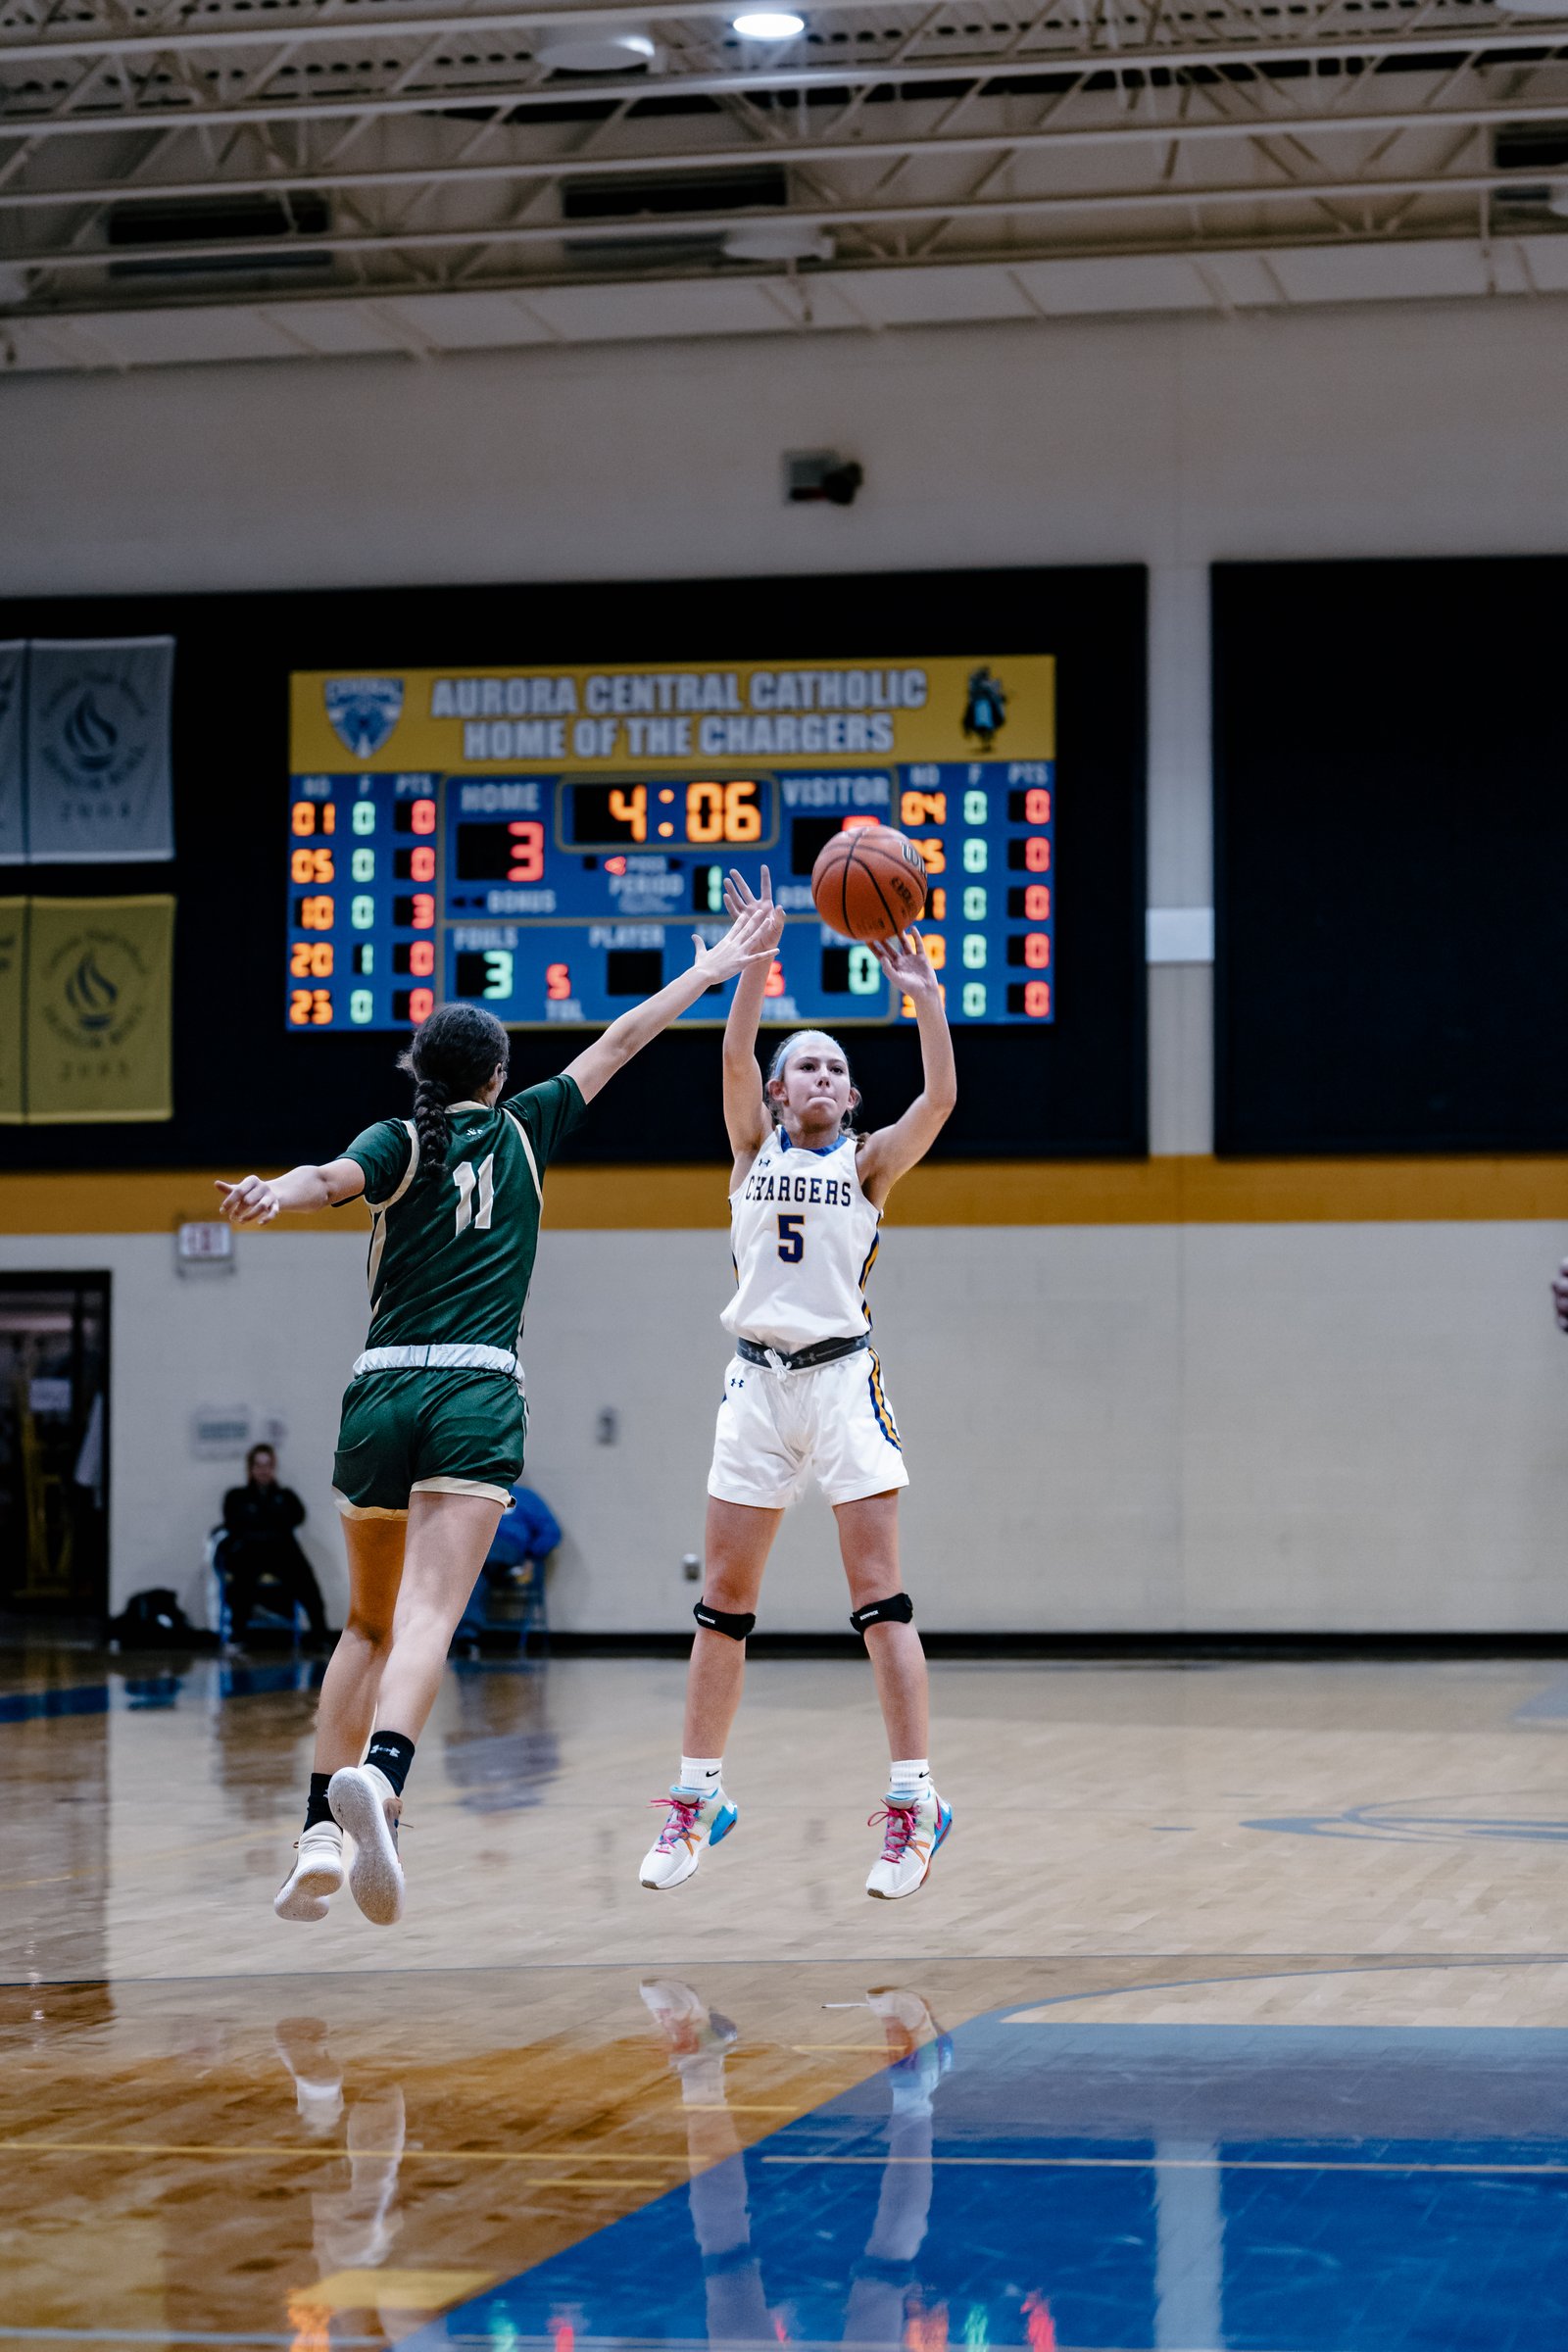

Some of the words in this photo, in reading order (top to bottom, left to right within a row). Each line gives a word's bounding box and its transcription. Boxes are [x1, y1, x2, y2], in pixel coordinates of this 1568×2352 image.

[432, 677, 577, 717] AURORA
[586, 672, 742, 714] CENTRAL
[750, 669, 927, 710] CATHOLIC
[464, 720, 566, 759] HOME
[573, 718, 618, 758] OF
[626, 716, 691, 757] THE
[700, 712, 894, 755] CHARGERS
[461, 783, 539, 812] HOME
[782, 777, 890, 807] VISITOR
[963, 790, 987, 825] 0
[1025, 789, 1051, 825] 0
[292, 802, 335, 837] 01
[353, 801, 374, 835] 0
[411, 799, 435, 834] 0
[609, 782, 761, 843] 4:06
[352, 848, 374, 883] 0
[410, 847, 435, 882] 0
[507, 821, 544, 882] 3
[963, 838, 987, 873] 0
[1025, 837, 1051, 872] 0
[487, 889, 556, 913] BONUS
[708, 865, 722, 912] 1
[963, 886, 987, 920] 0
[1025, 885, 1051, 920] 0
[352, 895, 374, 929] 0
[412, 893, 435, 929] 3
[589, 924, 665, 949] PLAYER
[963, 933, 987, 969] 0
[1024, 932, 1050, 968] 0
[290, 942, 333, 977] 20
[410, 941, 434, 977] 0
[484, 950, 513, 1000] 3
[849, 946, 880, 996] 0
[547, 963, 570, 1001] 5
[963, 982, 987, 1017] 0
[1024, 980, 1050, 1017] 0
[350, 989, 373, 1024] 0
[453, 1153, 495, 1237] 11
[745, 1175, 852, 1206] CHARGERS
[777, 1213, 805, 1264] 5
